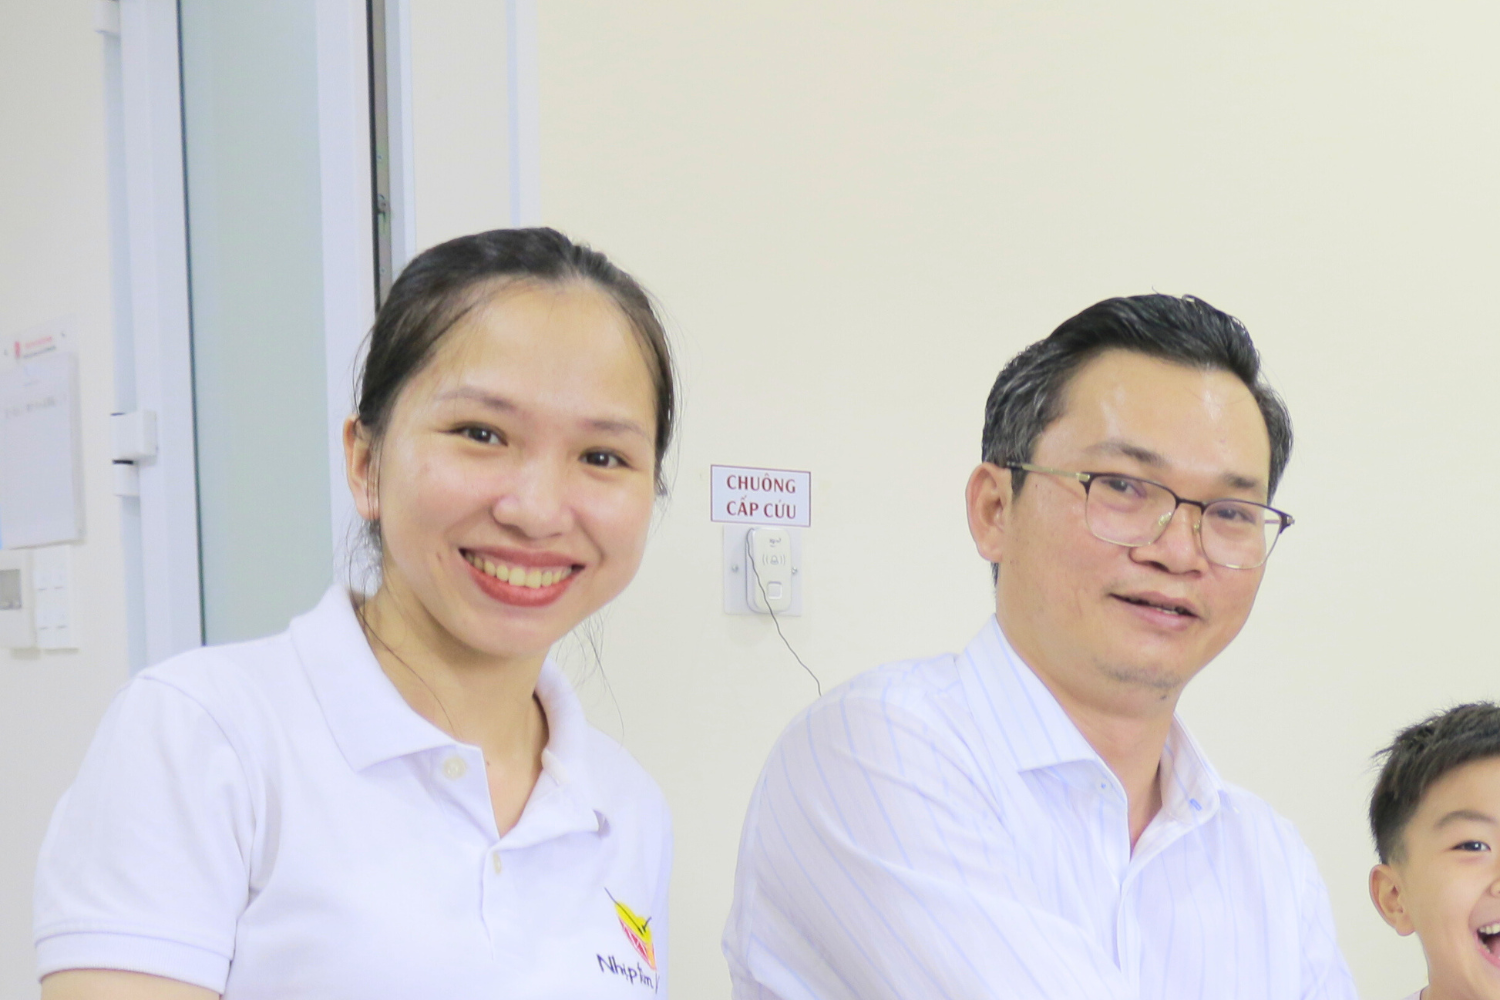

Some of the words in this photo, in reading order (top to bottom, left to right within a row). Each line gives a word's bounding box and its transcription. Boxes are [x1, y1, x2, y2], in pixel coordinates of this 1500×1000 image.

[726, 472, 796, 494] CHUÔNG
[726, 495, 759, 517] CẤP
[763, 499, 796, 519] CỨU
